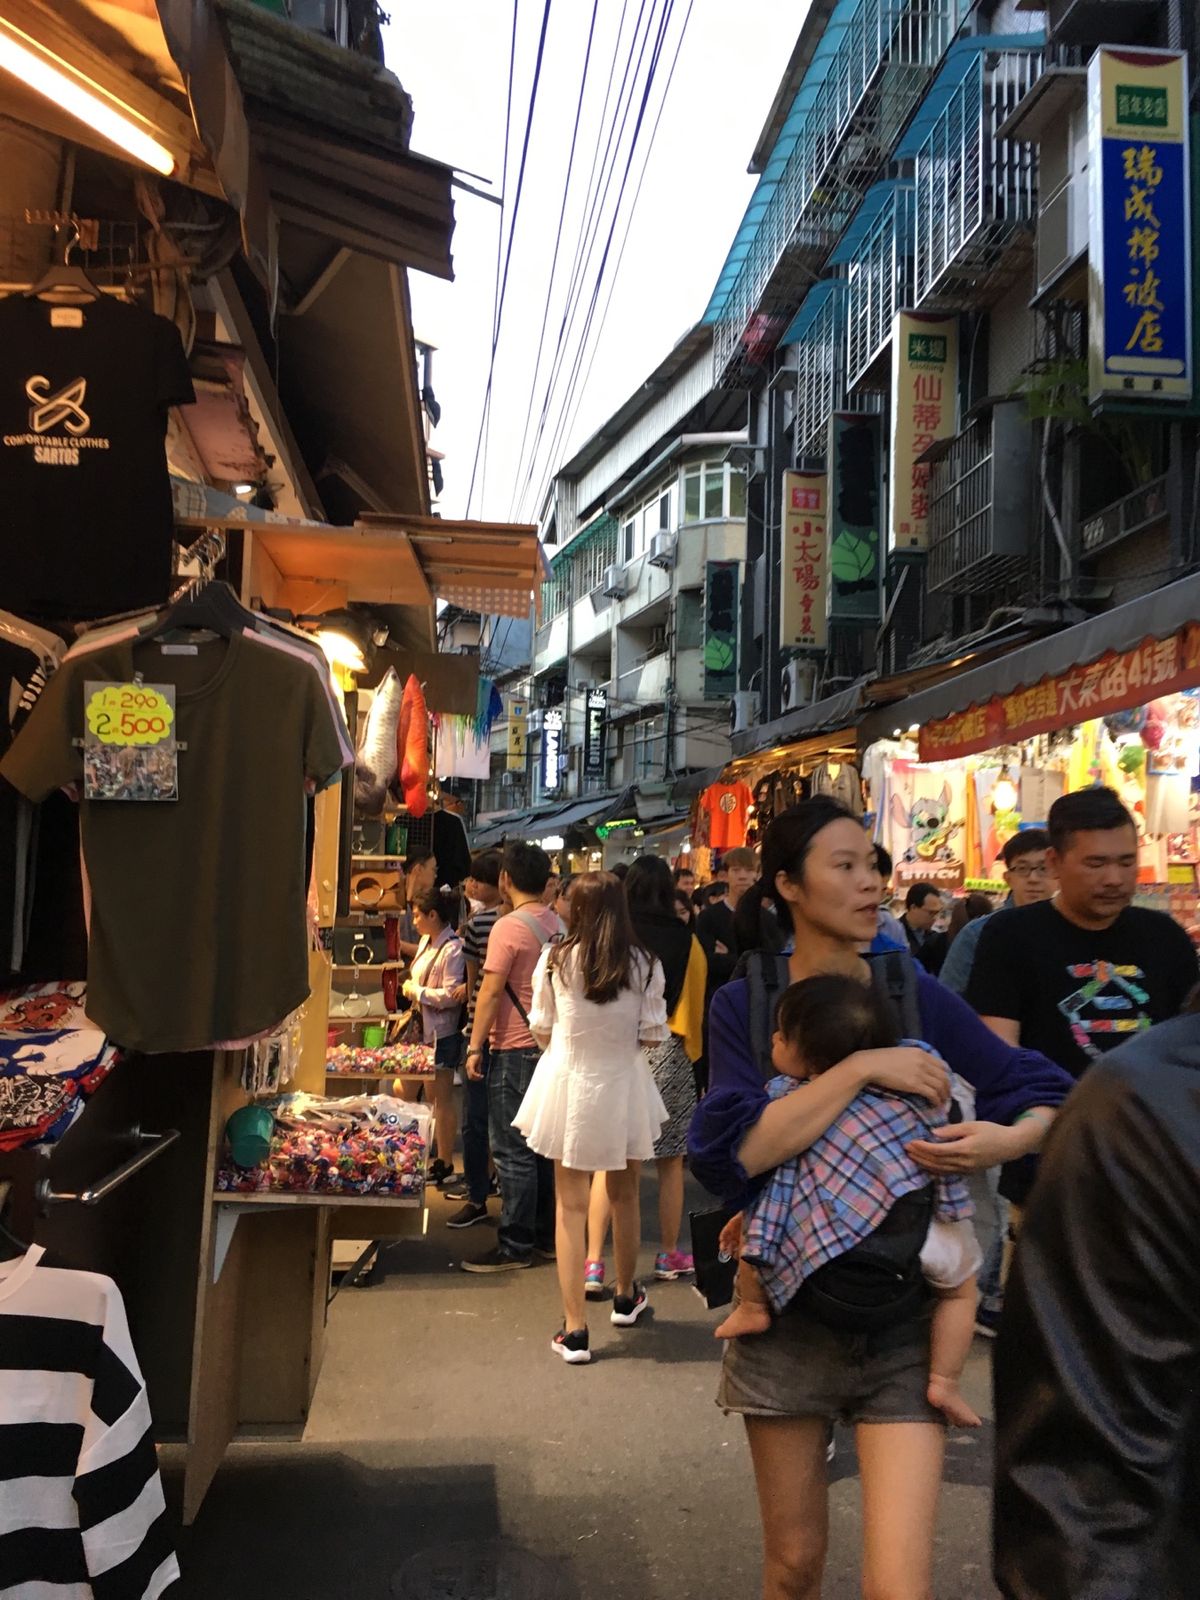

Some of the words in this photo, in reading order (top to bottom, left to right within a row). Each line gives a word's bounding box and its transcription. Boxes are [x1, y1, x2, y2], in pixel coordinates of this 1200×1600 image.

[1122, 144, 1164, 353] 瑞成棉被店
[3, 433, 69, 447] COMFORTABLE
[69, 437, 110, 449] CLOTHES
[34, 446, 79, 465] SARTOS
[792, 520, 824, 635] 小太陽童裝
[120, 691, 159, 709] 290
[120, 713, 166, 737] 500
[900, 868, 961, 880] STITCH
